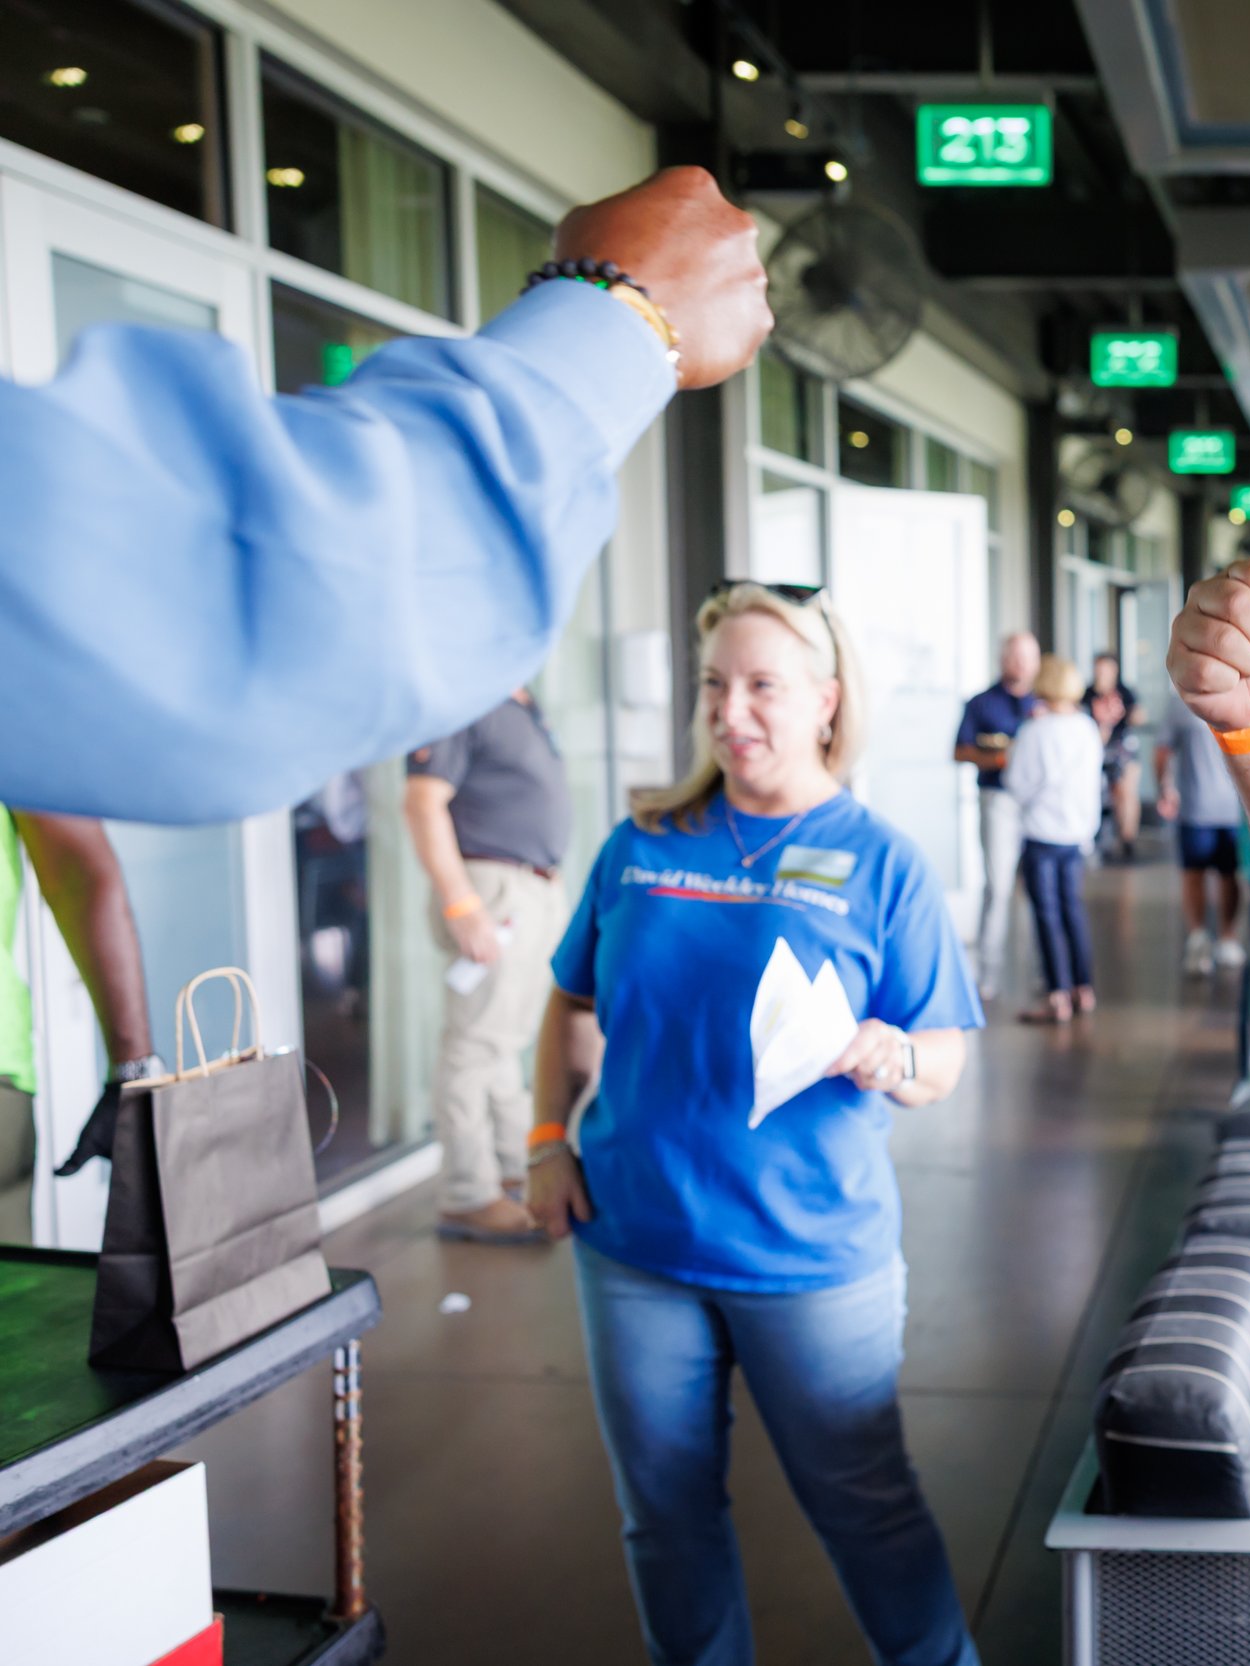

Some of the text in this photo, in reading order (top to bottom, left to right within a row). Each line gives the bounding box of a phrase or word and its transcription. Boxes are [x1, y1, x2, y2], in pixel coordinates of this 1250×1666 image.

[940, 116, 1031, 164] 213
[620, 865, 850, 917] David Weekley Homes
